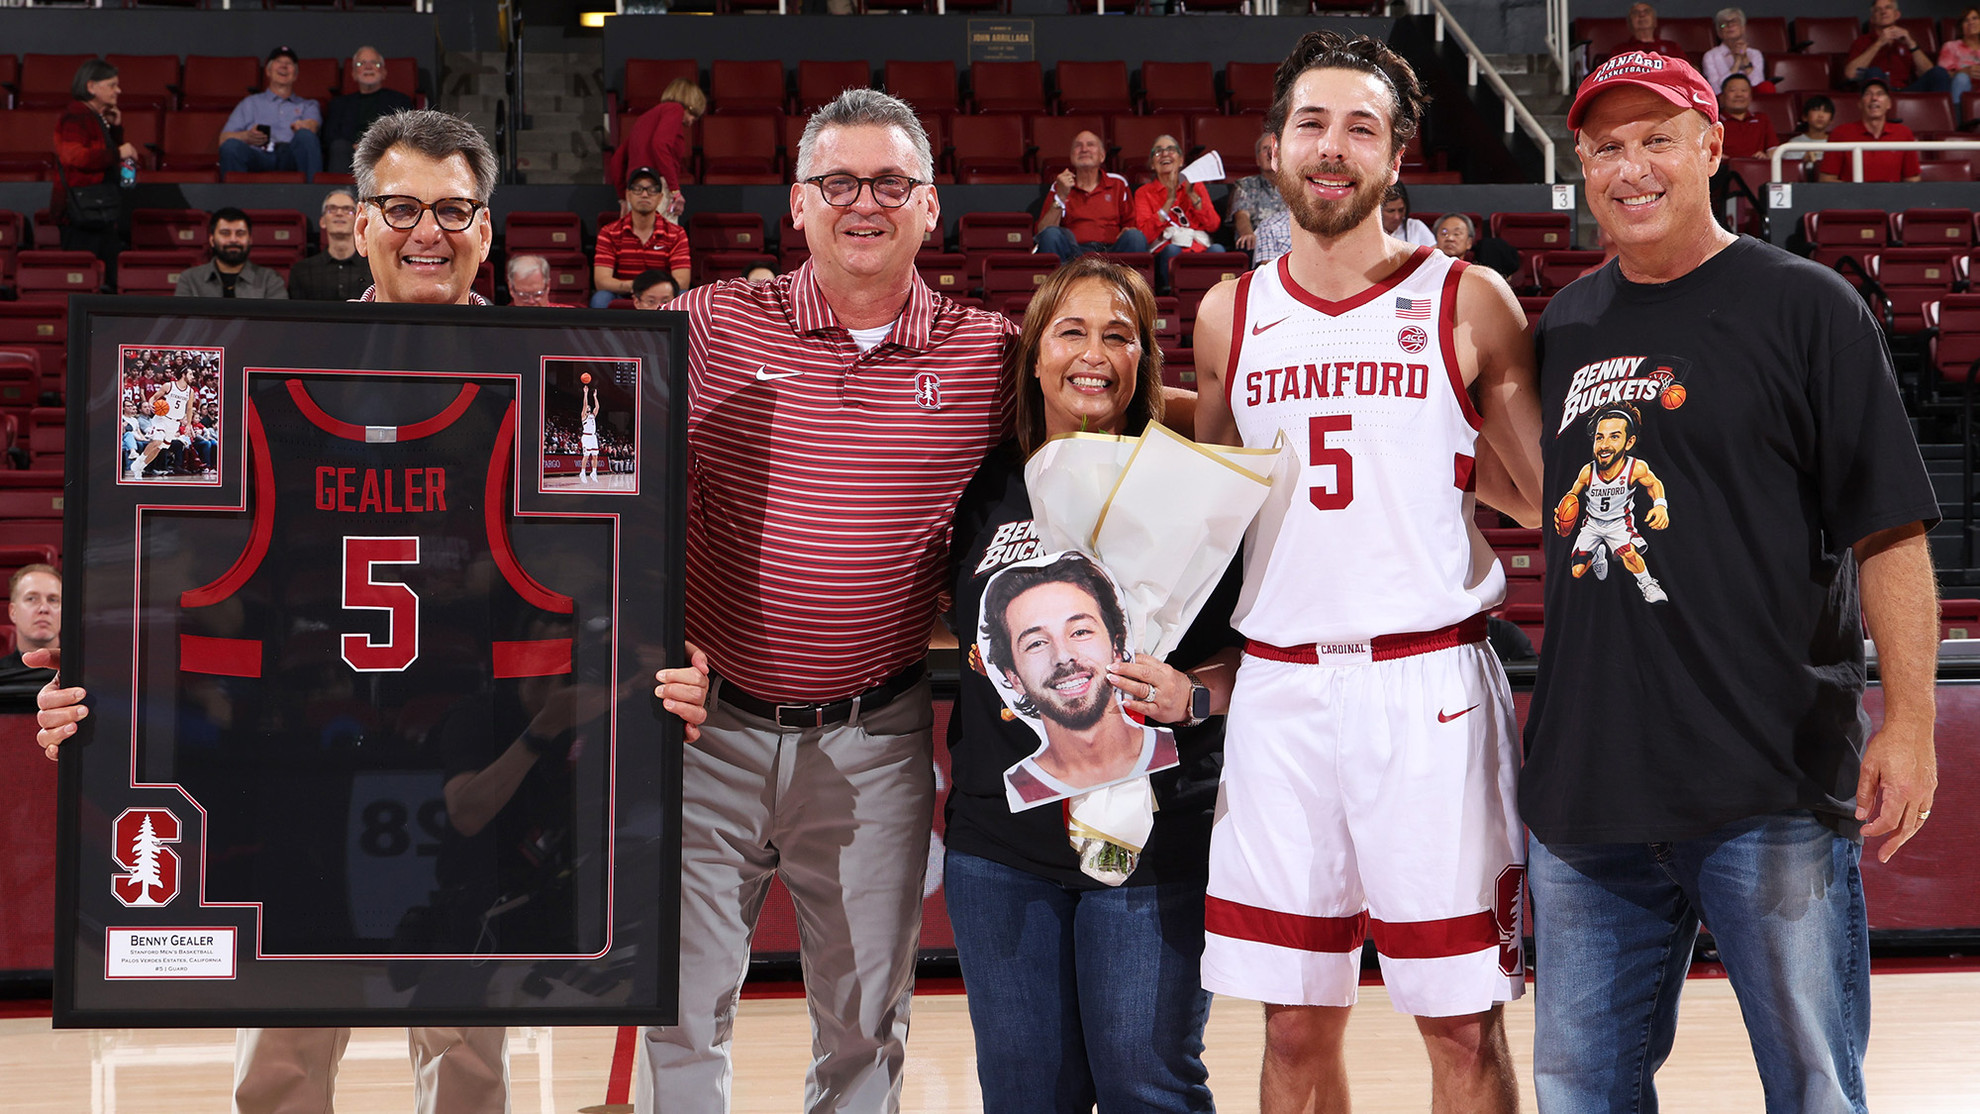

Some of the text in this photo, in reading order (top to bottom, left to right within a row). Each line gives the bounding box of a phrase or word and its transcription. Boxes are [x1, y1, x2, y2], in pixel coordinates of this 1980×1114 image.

[1598, 66, 1650, 82] BASKETBALL
[1559, 192, 1568, 208] 3
[1775, 191, 1784, 207] 2
[1246, 361, 1429, 407] STANFORD
[1564, 356, 1646, 404] BENNY
[174, 400, 181, 410] 5
[1556, 378, 1660, 439] BUCKETS
[1309, 414, 1354, 511] 5
[315, 466, 447, 513] GEALER
[1591, 487, 1626, 497] STANFORD
[1600, 497, 1611, 512] 5
[986, 519, 1040, 551] BEN
[974, 540, 1047, 577] BUCK
[341, 536, 420, 672] 5
[1321, 644, 1366, 654] CARDINAL
[130, 934, 214, 946] BENNY GEALER
